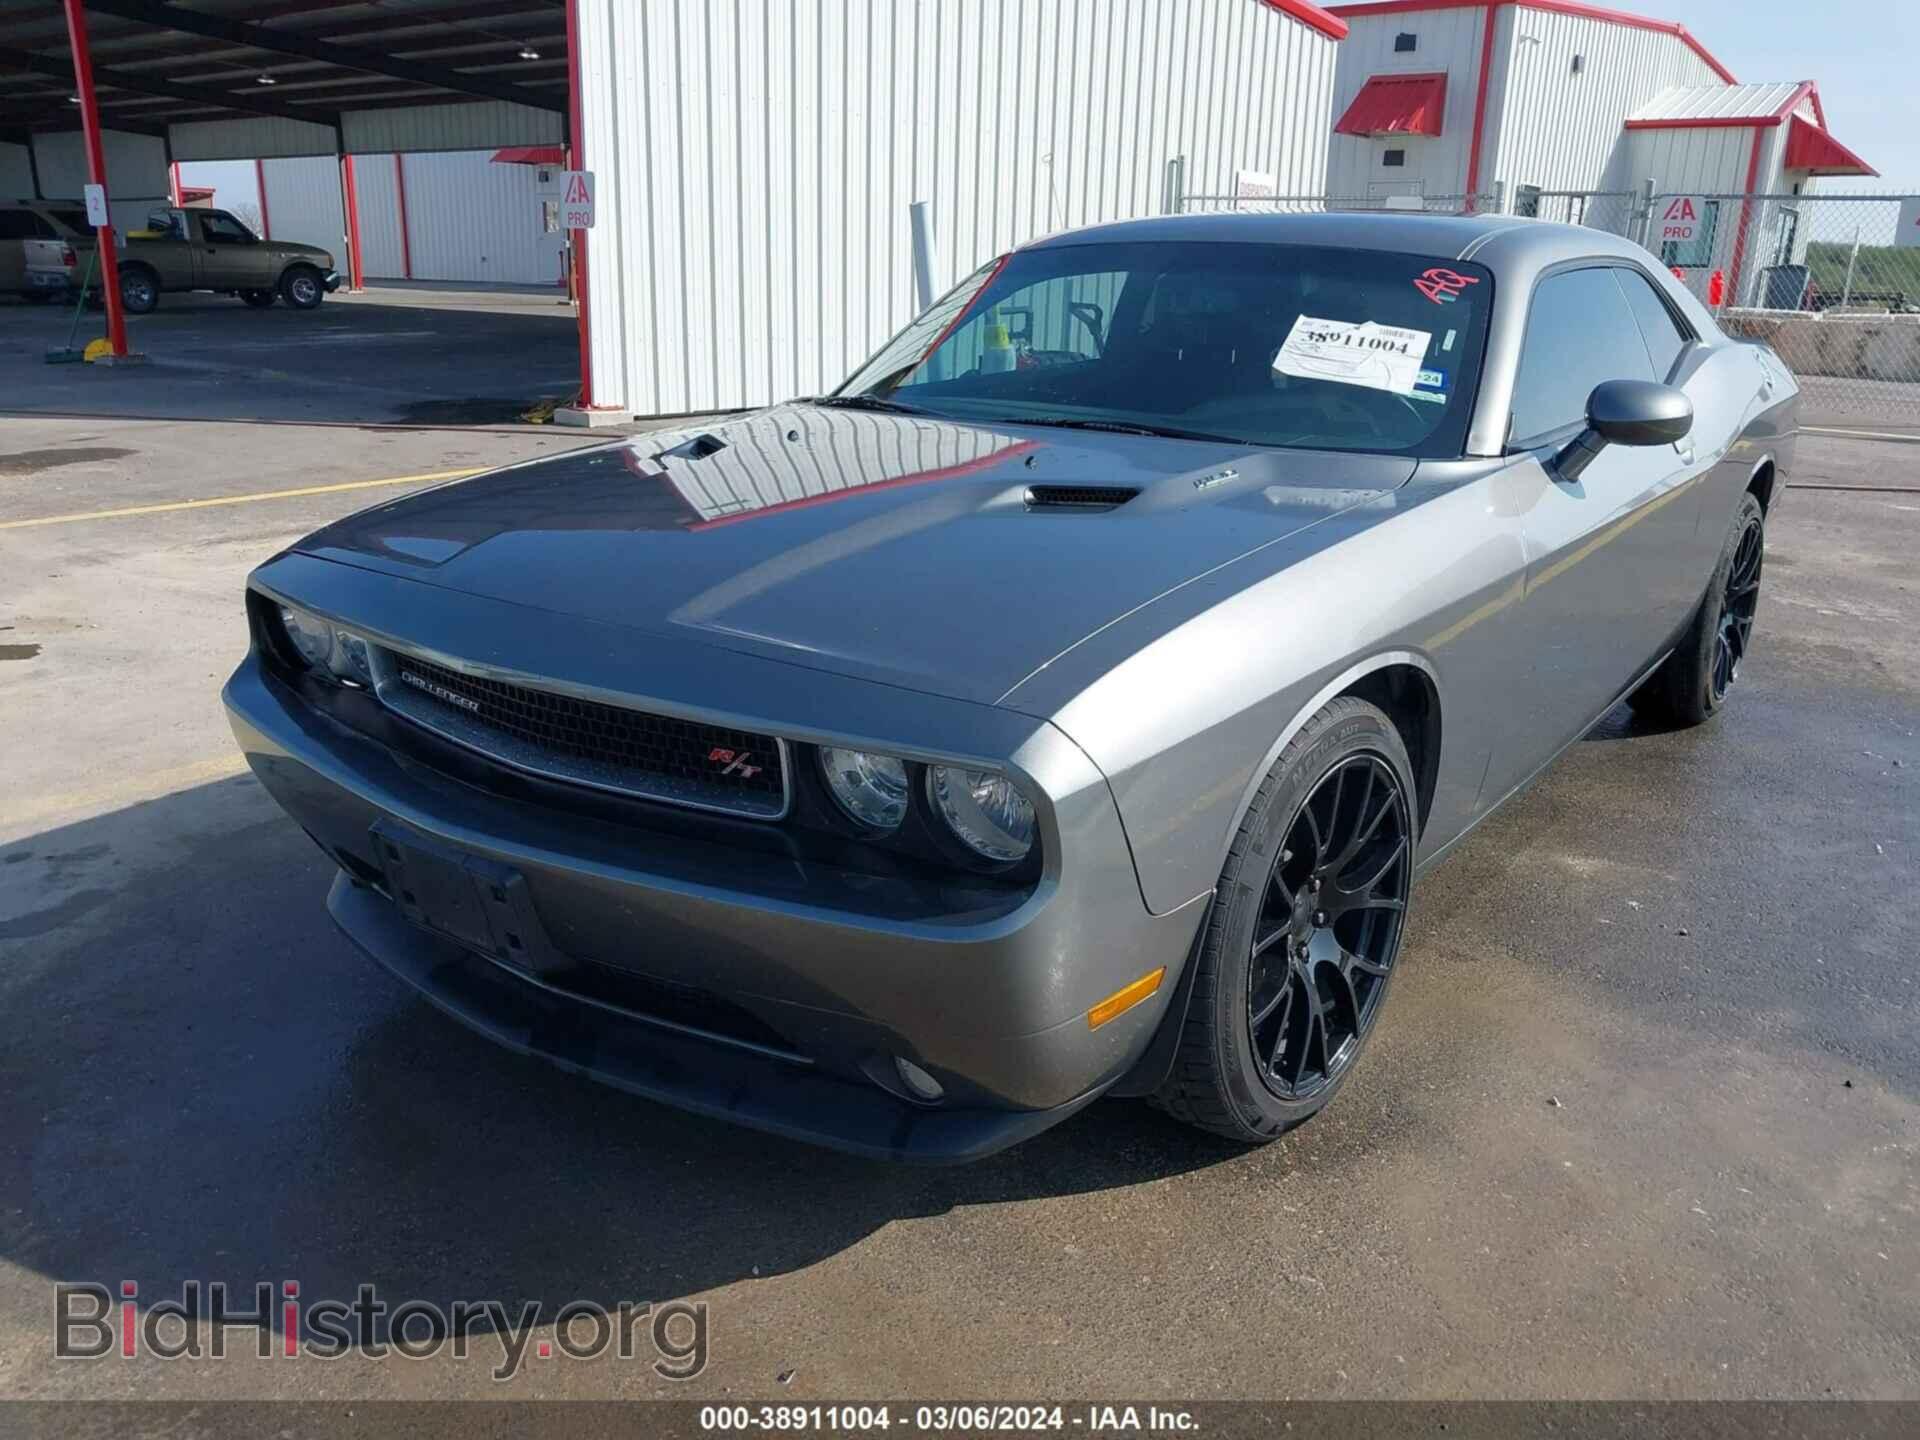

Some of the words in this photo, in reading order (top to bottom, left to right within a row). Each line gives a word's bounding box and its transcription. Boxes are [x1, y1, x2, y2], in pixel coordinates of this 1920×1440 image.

[567, 211, 590, 226] PRO
[1663, 226, 1693, 238] PRO
[401, 671, 478, 713] CHALLENGER
[708, 748, 763, 779] R/T
